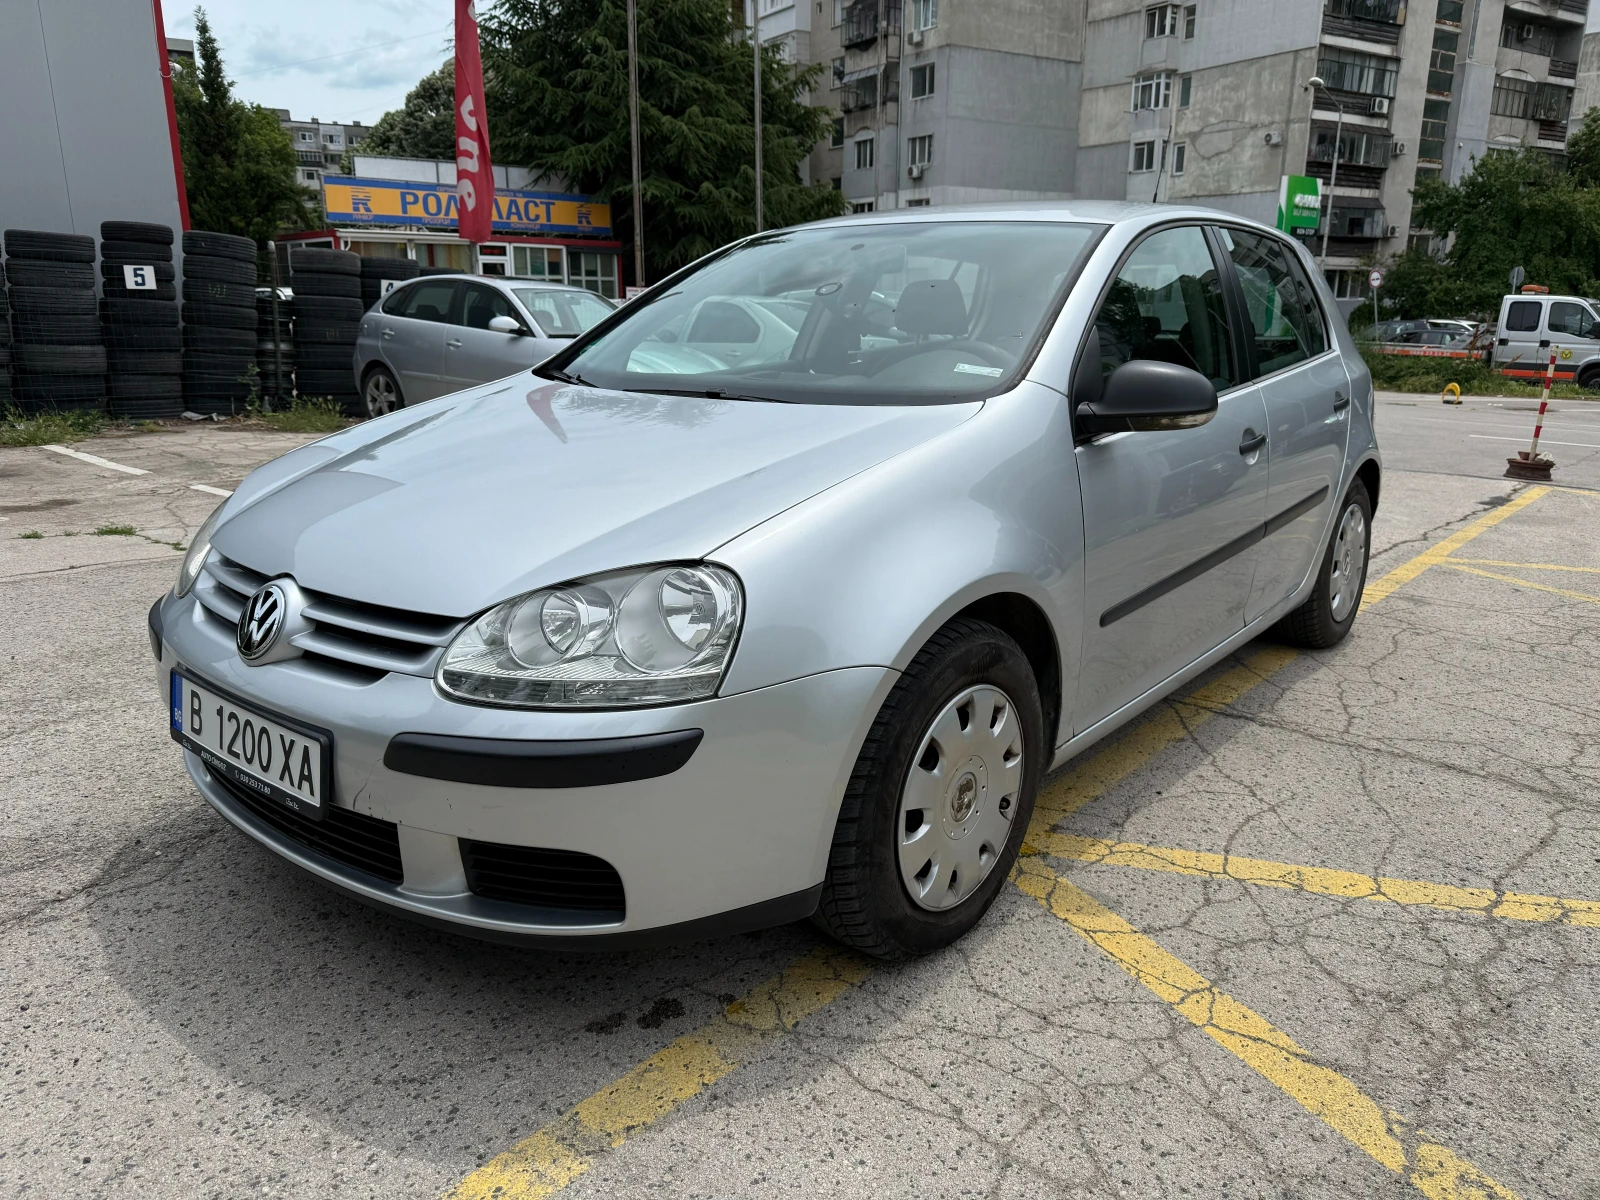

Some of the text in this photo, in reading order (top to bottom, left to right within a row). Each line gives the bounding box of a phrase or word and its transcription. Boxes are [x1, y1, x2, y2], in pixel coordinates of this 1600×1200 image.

[400, 191, 555, 223] РОЛАСТ
[133, 267, 146, 286] 5
[174, 707, 182, 723] BG
[190, 689, 315, 797] B 1200 XA
[201, 750, 211, 762] AUTO
